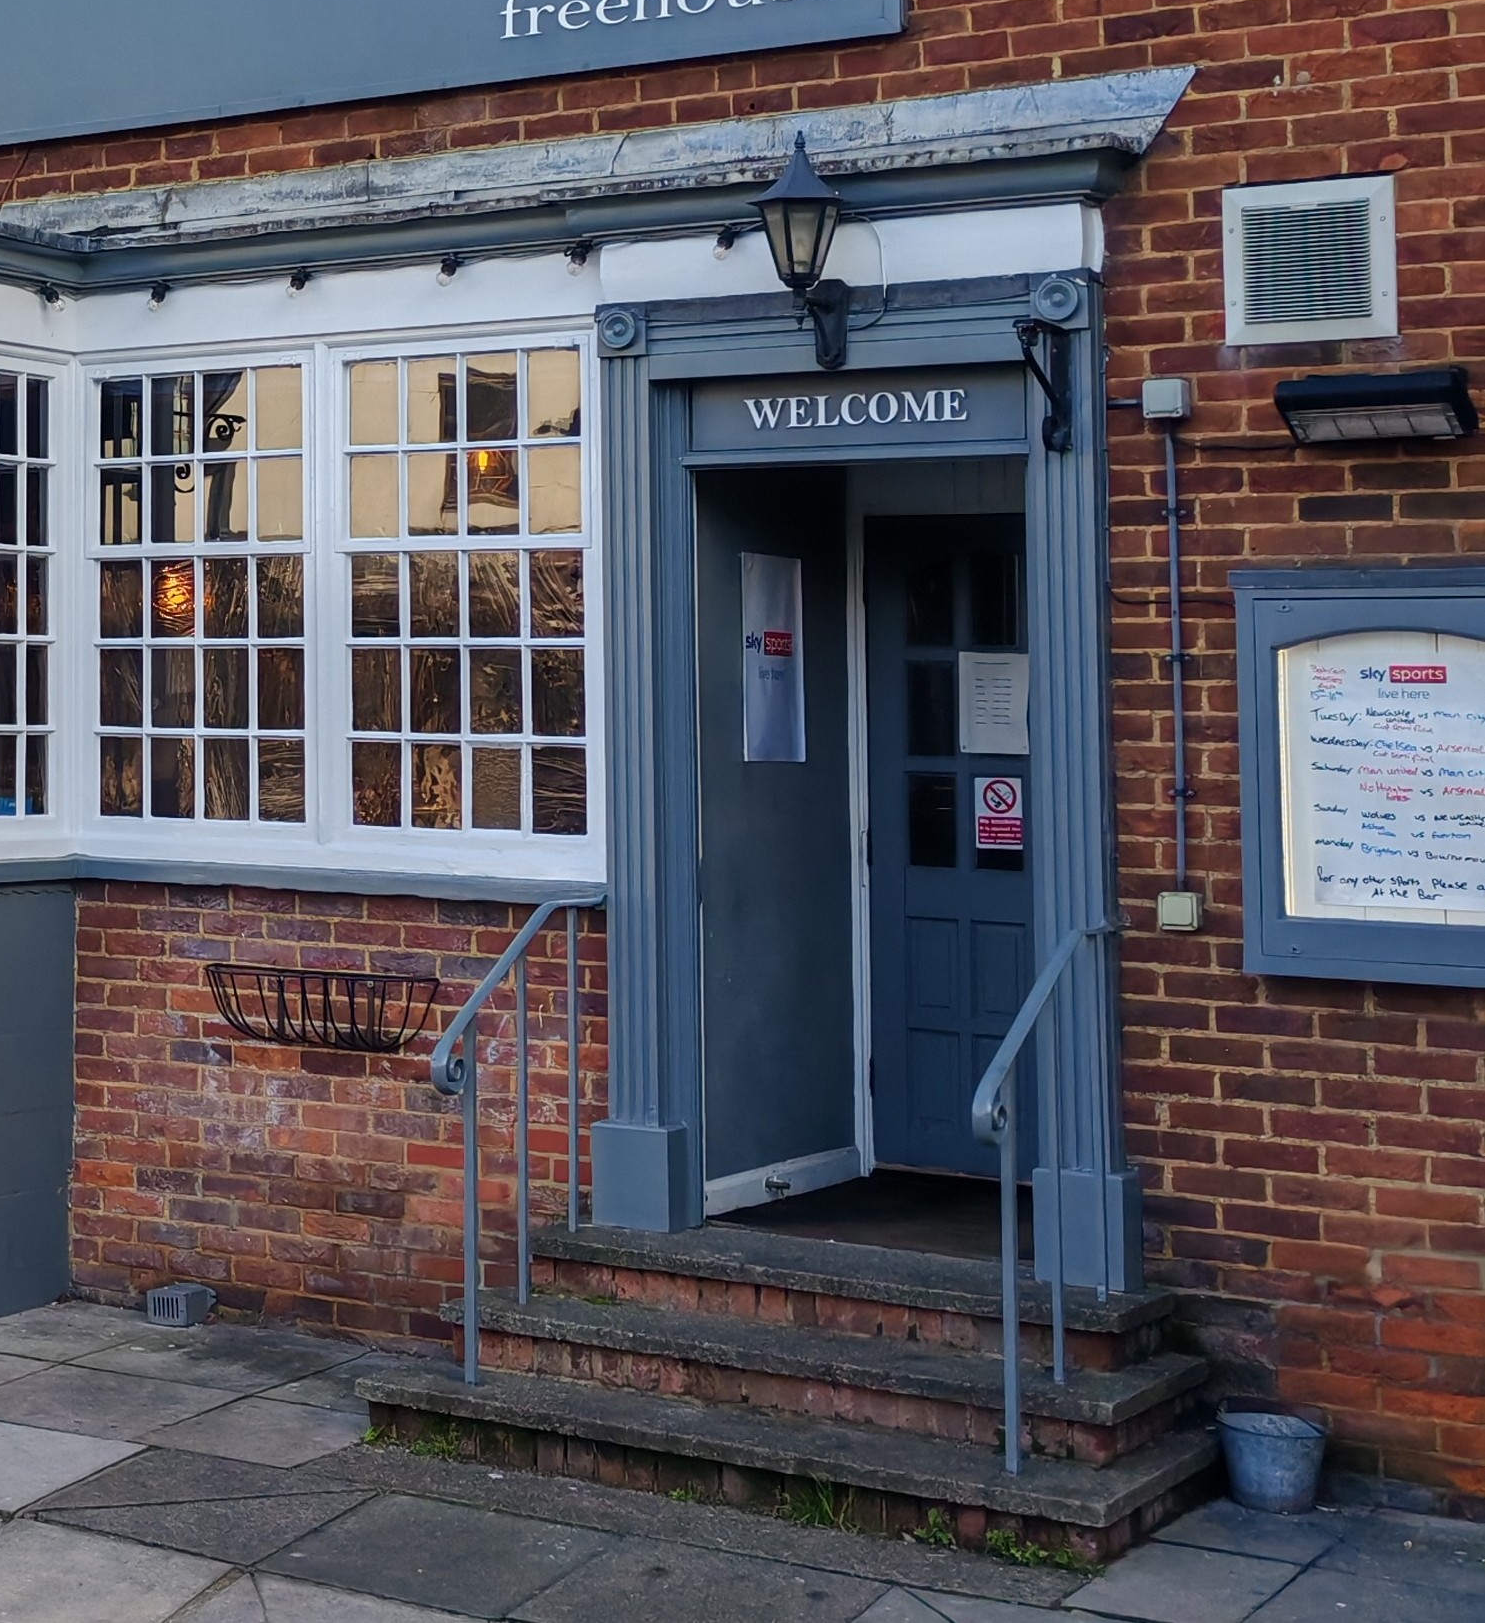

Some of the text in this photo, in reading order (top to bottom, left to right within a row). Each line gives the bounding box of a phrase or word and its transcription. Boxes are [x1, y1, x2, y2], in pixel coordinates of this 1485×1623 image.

[743, 388, 968, 429] WELCOME
[745, 631, 762, 653] sky
[1359, 667, 1387, 682] sky
[1391, 668, 1444, 682] sports
[1378, 687, 1430, 700] live here
